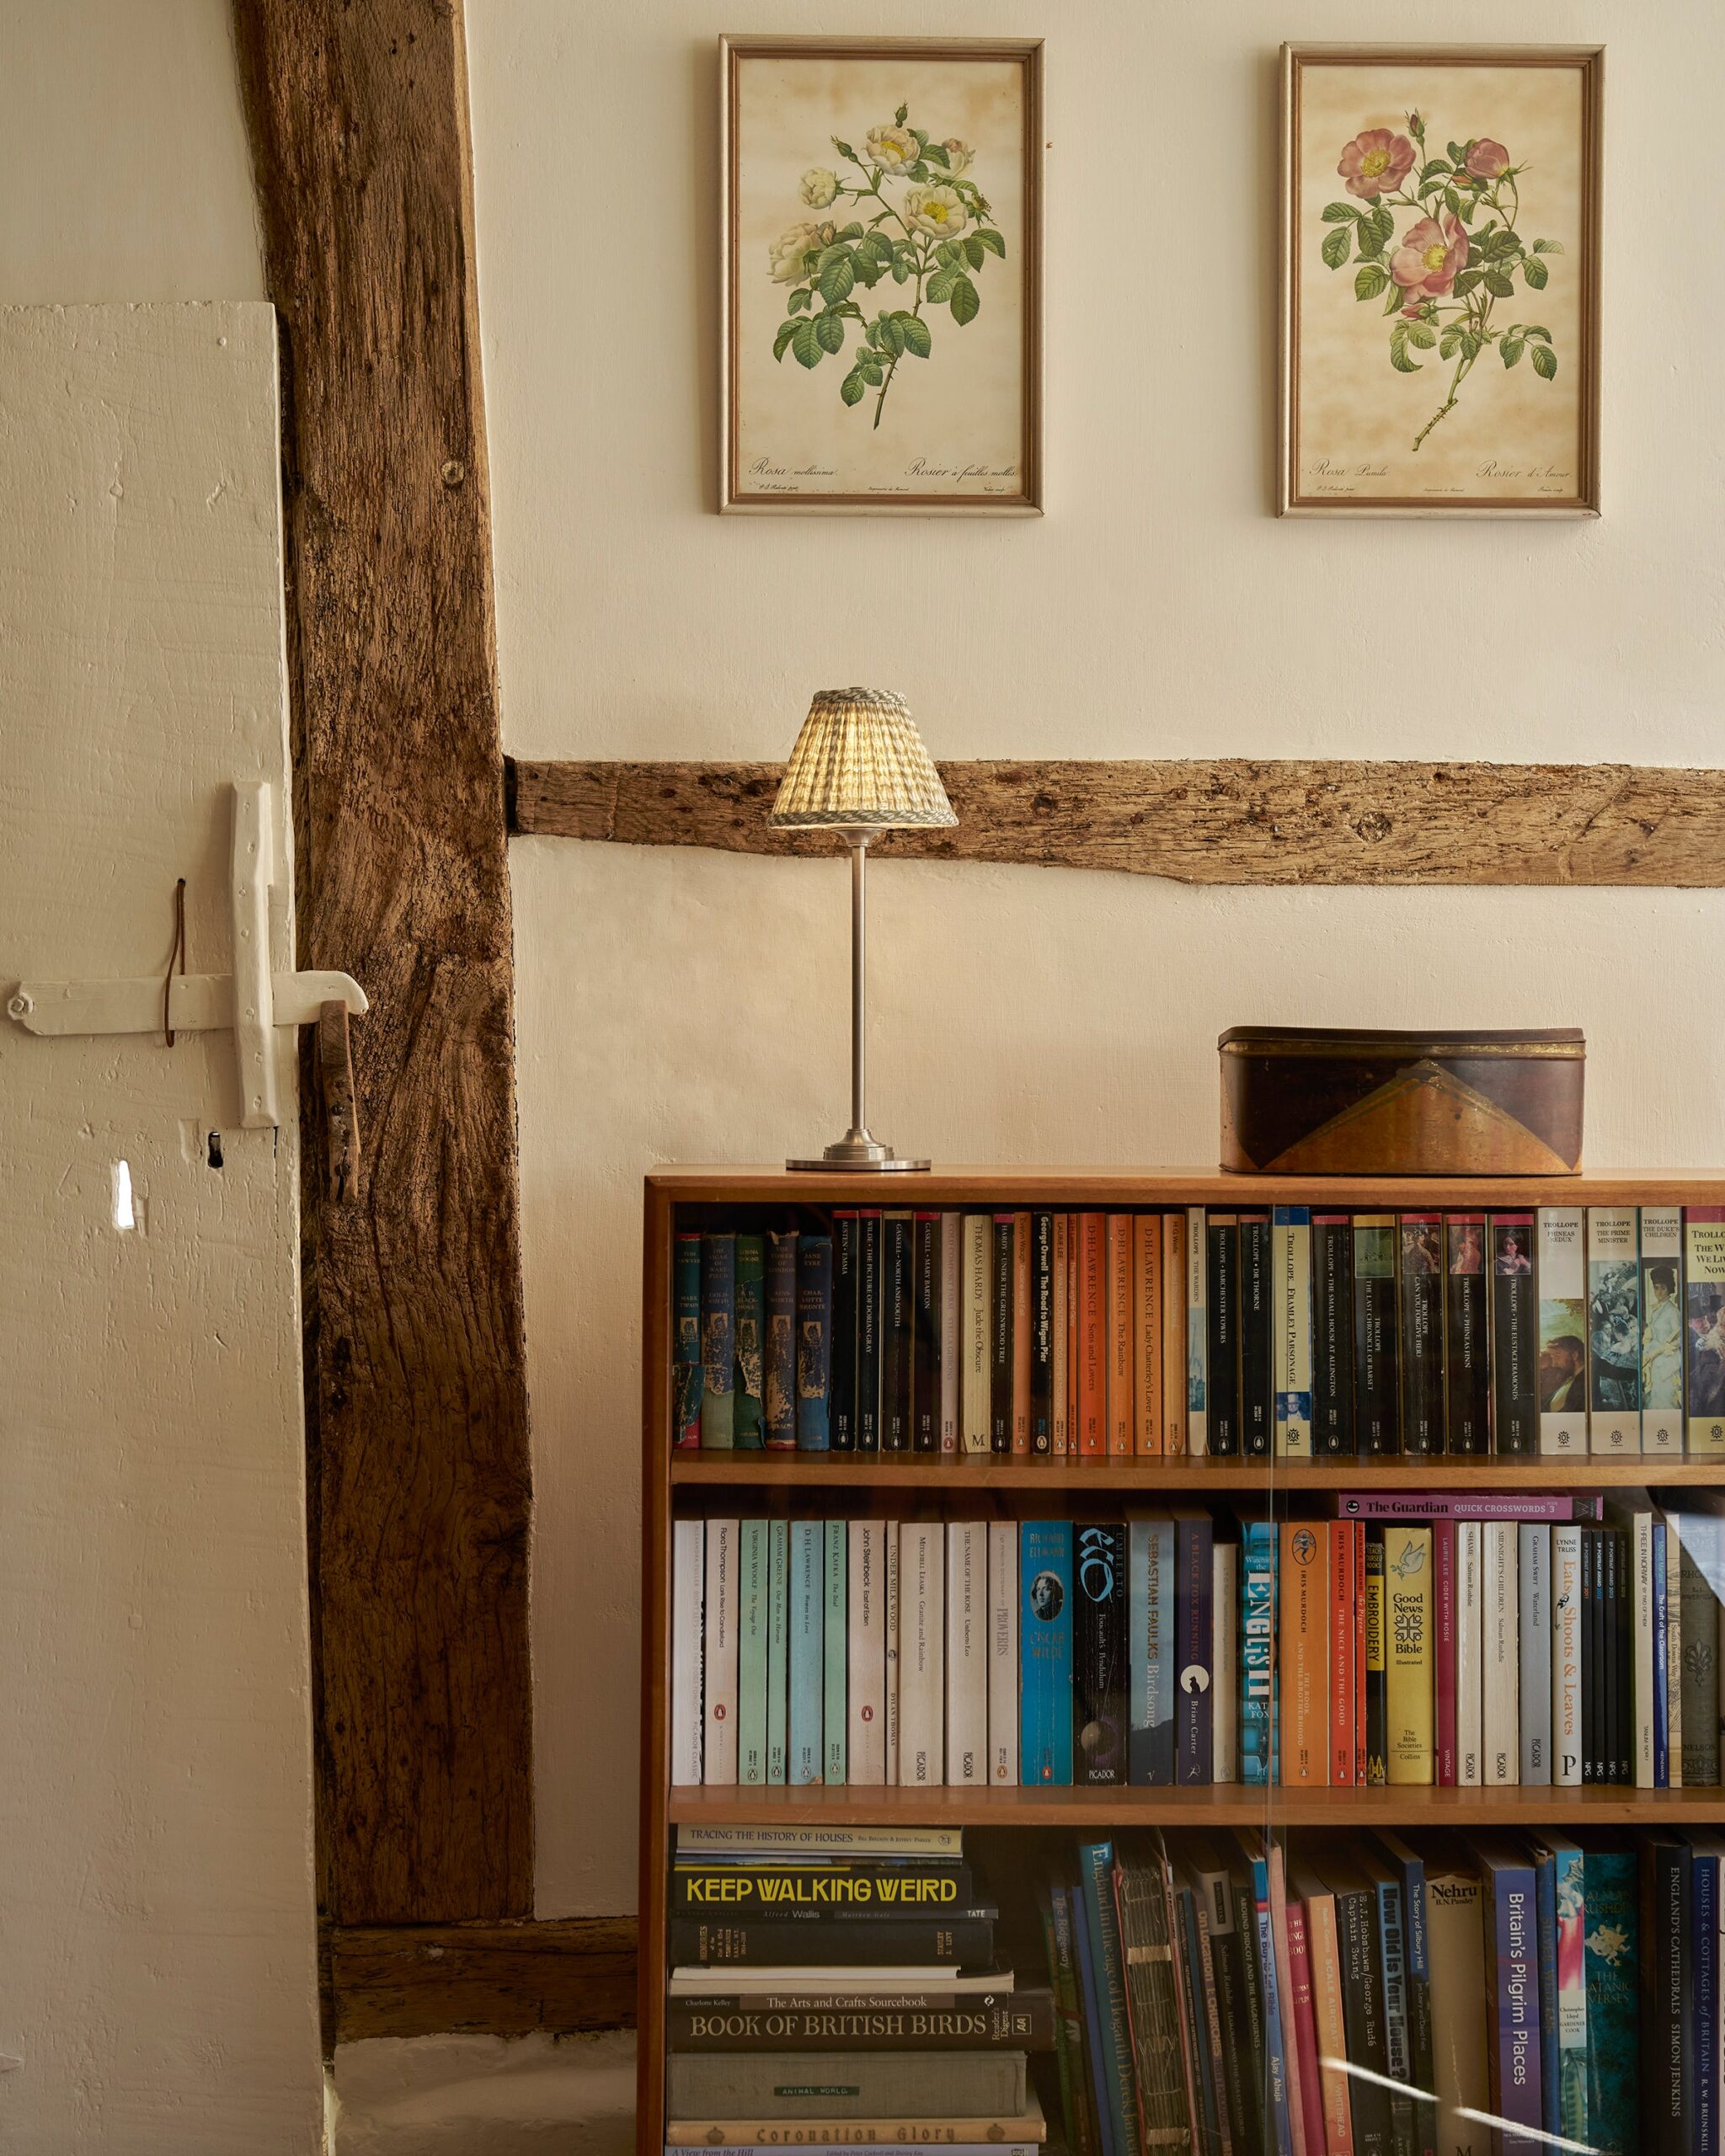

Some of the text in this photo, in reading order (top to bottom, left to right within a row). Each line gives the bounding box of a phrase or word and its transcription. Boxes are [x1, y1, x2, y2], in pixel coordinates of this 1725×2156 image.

[749, 457, 788, 475] Rosa
[905, 457, 950, 476] Rosier
[1309, 458, 1347, 475] Rosa
[1476, 460, 1521, 478] Rosier
[1252, 1268, 1260, 1279] DR
[975, 1224, 984, 1374] THOMAS HARDY Jude the Obscure
[1039, 1217, 1049, 1363] George Orwell The Road to Wigan Pier
[1287, 1233, 1296, 1385] TROLLOPE FRAMLEY PARSONAGE
[1366, 1502, 1556, 1513] The Guardian QUICK CROSSWORDS 3
[1115, 1533, 1124, 1598] UMBERTO
[1300, 1569, 1308, 1634] IRIS MURDOCH
[1393, 1593, 1423, 1604] Good
[1394, 1603, 1423, 1614] News
[996, 1608, 1009, 1657] PROVERBS
[1144, 1534, 1161, 1728] SEBASTIAN FAULKS Birdsong
[1338, 1530, 1346, 1726] IRIS MURDOCH THE NICE AND THE GOOD
[1367, 1584, 1380, 1662] EMBROIDERY
[1563, 1606, 1577, 1657] Shoots
[1097, 1614, 1107, 1689] Foucault's Pendulum
[1396, 1643, 1423, 1654] Bible
[1563, 1663, 1577, 1678] &
[1563, 1684, 1577, 1736] Leaves
[1189, 1700, 1199, 1755] Brian Carter
[916, 1751, 927, 1781] PICADOR
[964, 1752, 973, 1778] PICADOR
[1466, 1753, 1475, 1779] PICADOR
[1497, 1753, 1506, 1778] PICADOR
[1532, 1738, 1541, 1768] PICADOR
[1089, 1769, 1115, 1779] PICADOR
[690, 1829, 853, 1843] TRACING THE HISTORY OF HOUSES
[686, 1878, 958, 1902] KEEP WALKING WEIRD
[1430, 1884, 1477, 1898] Nehru
[967, 1909, 986, 1919] TATE
[1382, 1887, 1406, 2079] How Old is Your House?
[1508, 1892, 1529, 2086] Britain's Pilgrim Places
[1669, 1866, 1681, 2118] ENGLAND'S CATHEDRALS SIMON JENKINS
[766, 1997, 927, 2008] The Arts and Crafts Sourcebook
[1699, 1868, 1712, 2153] HOUSES & COTTAGES of BRITAIN R. W. BRUNSKILL
[690, 2014, 987, 2036] BOOK OF BRITISH BIRDS
[1000, 2009, 1009, 2039] Digest
[1334, 2082, 1347, 2138] WHITEHEAD
[756, 2127, 956, 2143] Coronation Glory
